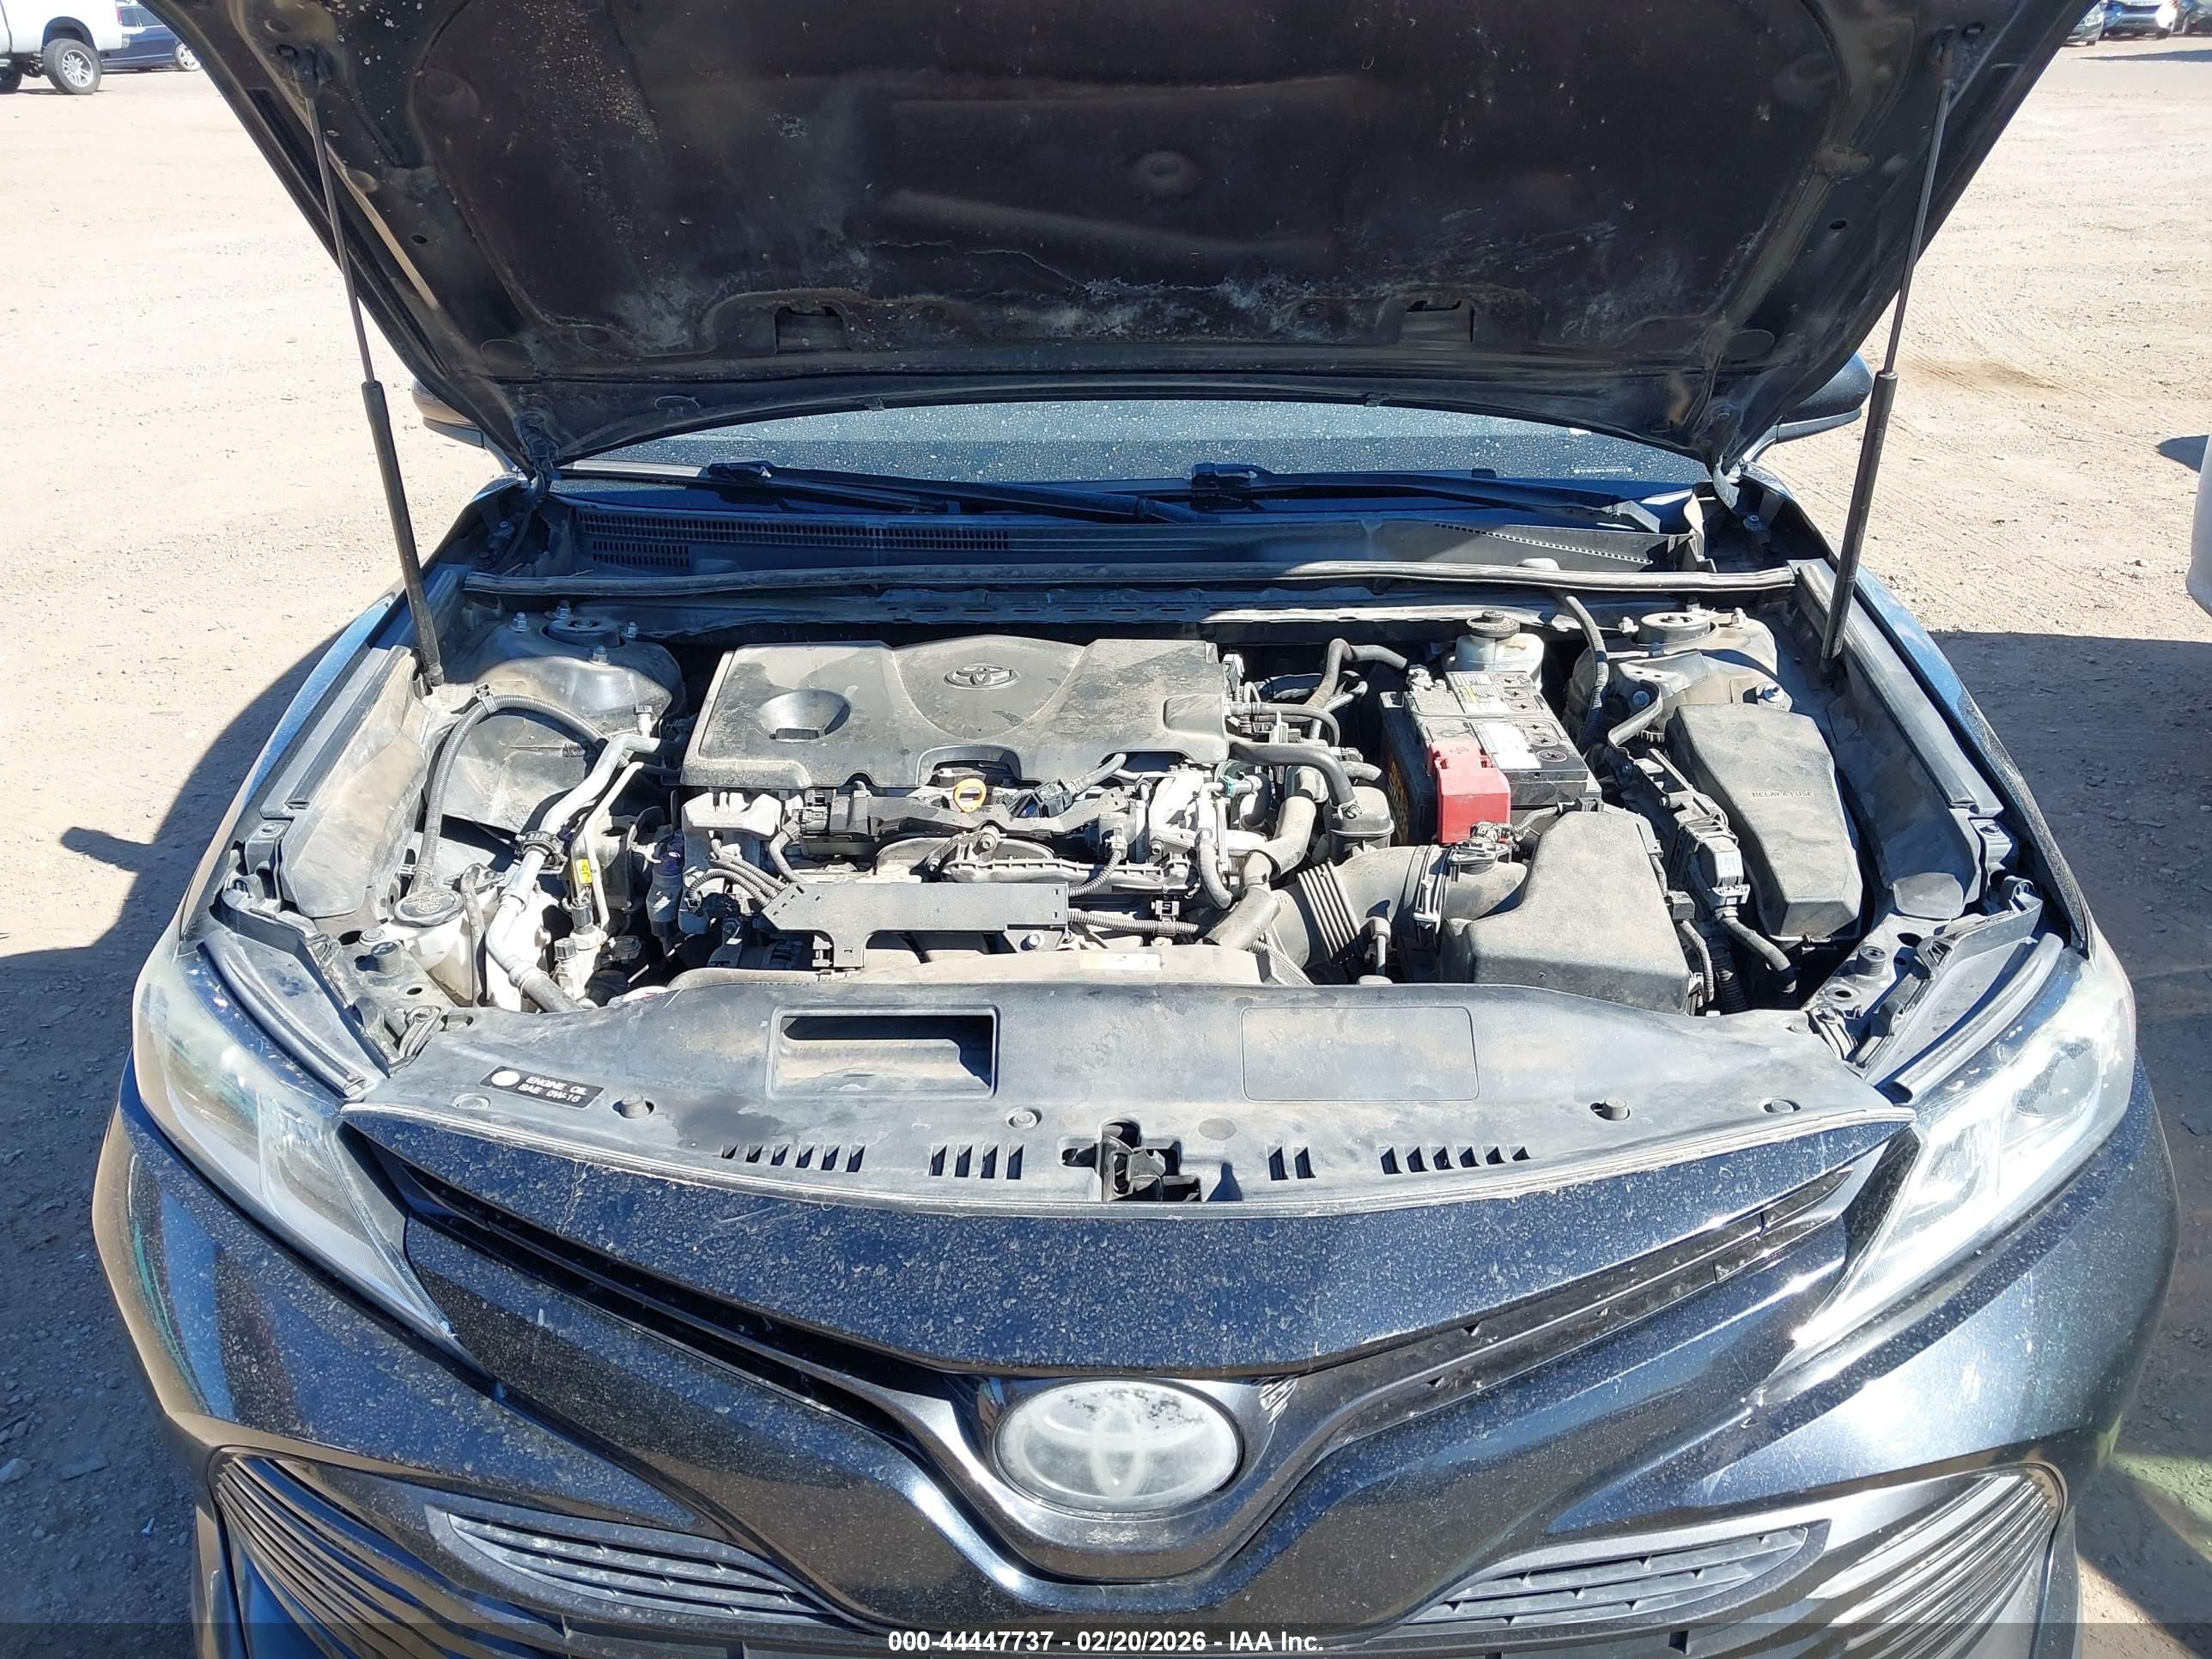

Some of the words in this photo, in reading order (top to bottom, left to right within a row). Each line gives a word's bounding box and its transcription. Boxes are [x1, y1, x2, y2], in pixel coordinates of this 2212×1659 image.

[518, 1083, 544, 1095] SAE
[545, 1090, 581, 1103] 0W-16
[526, 1076, 568, 1091] ENGINE
[569, 1085, 588, 1096] OIL
